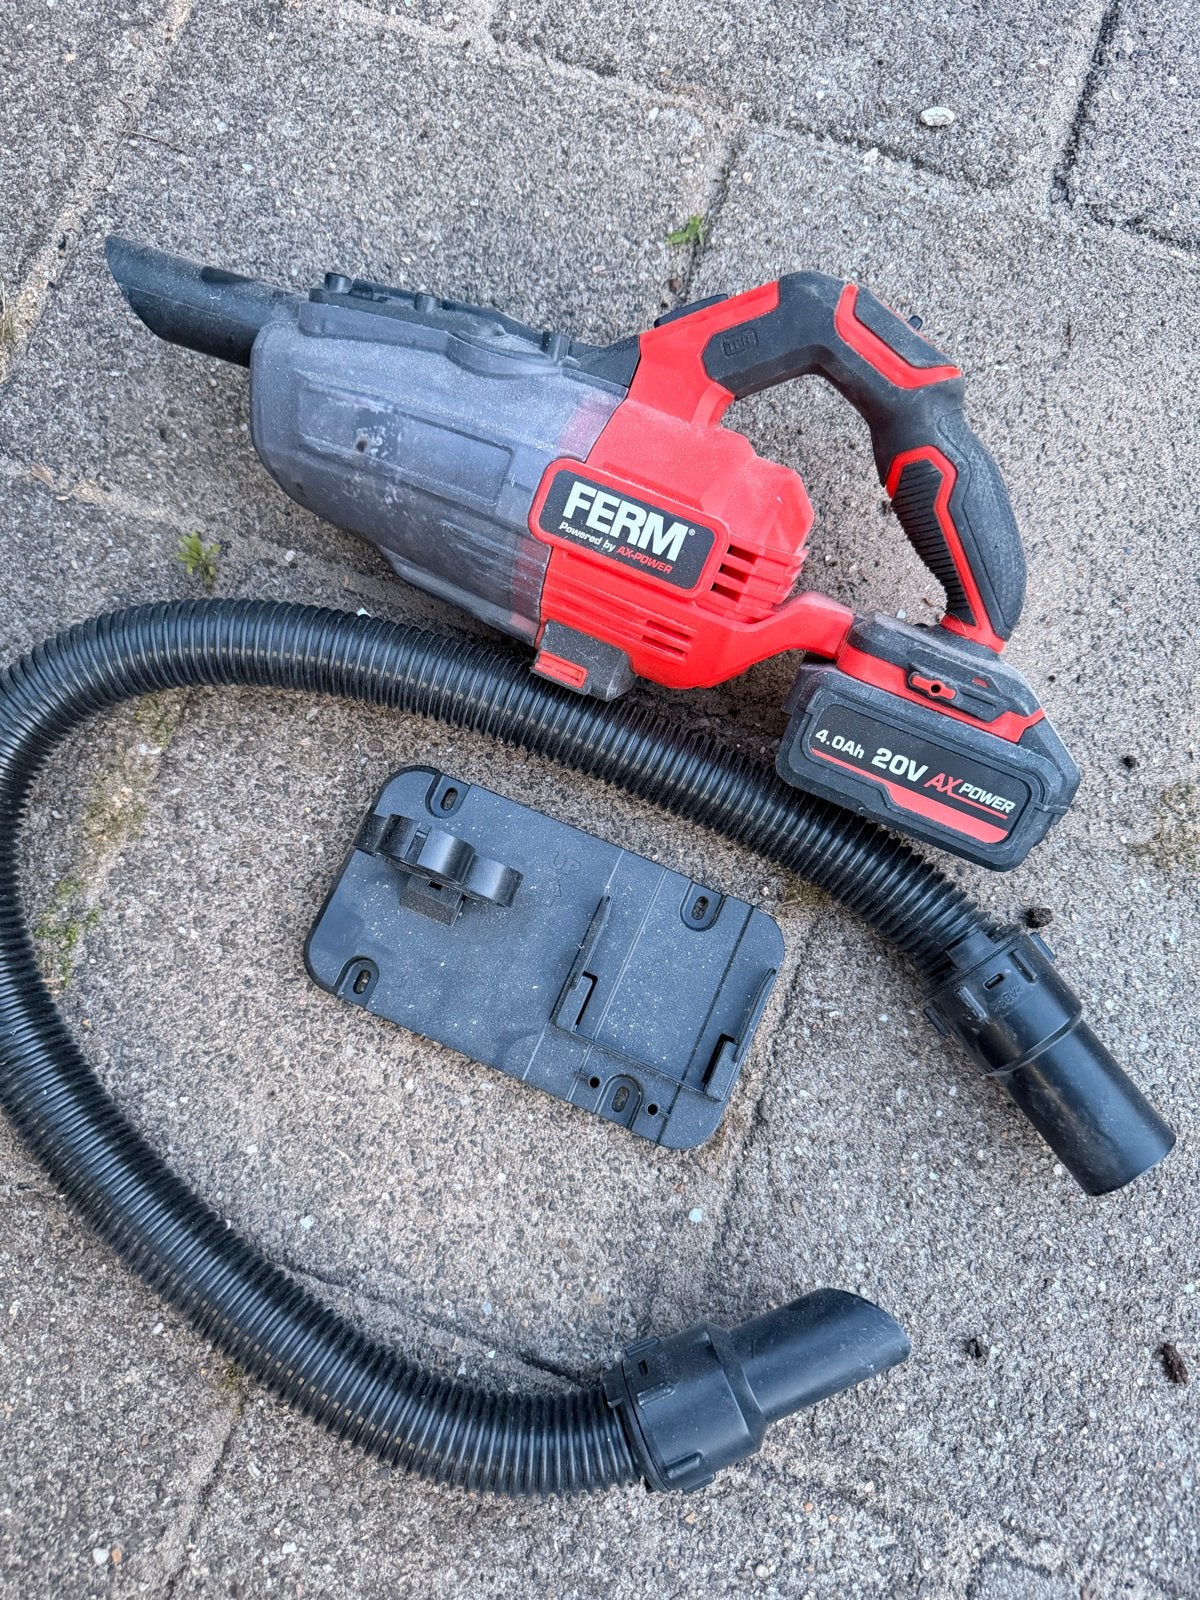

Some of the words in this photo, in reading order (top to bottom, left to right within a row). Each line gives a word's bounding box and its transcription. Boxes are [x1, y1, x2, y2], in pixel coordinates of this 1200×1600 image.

[558, 521, 603, 546] Powered
[602, 541, 616, 552] by
[616, 545, 673, 574] AX-POWER
[815, 729, 865, 759] 4.0Ah
[872, 748, 928, 781] 20V
[958, 783, 1015, 813] POWER
